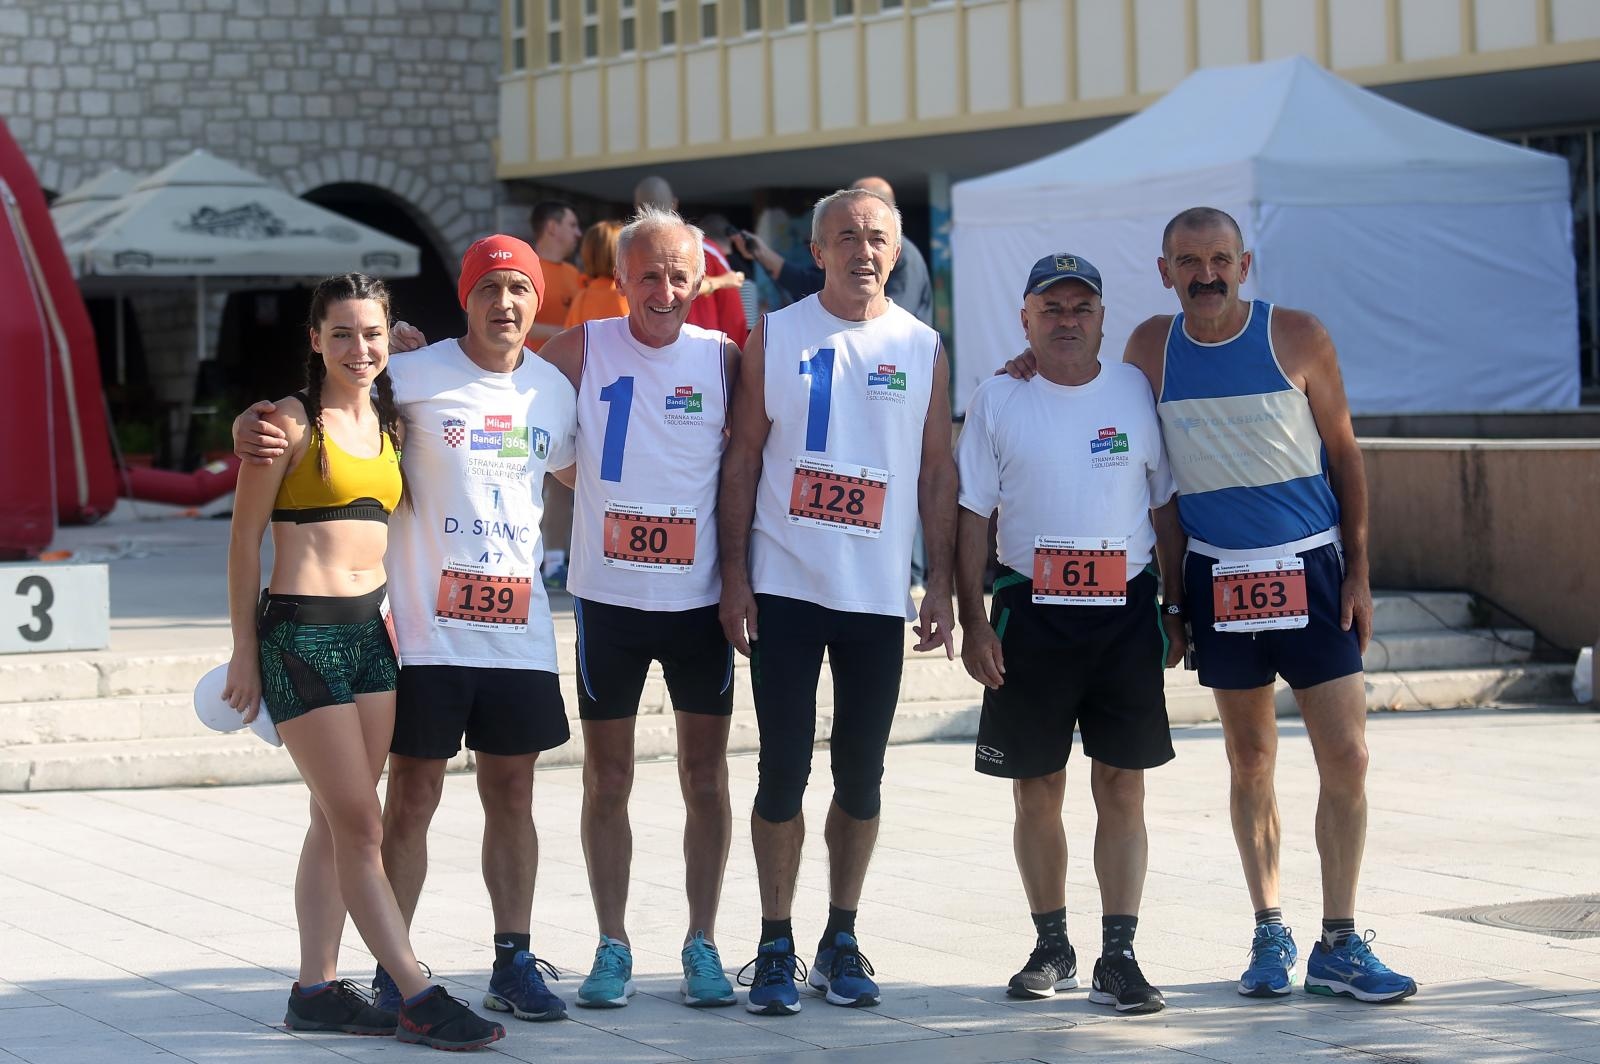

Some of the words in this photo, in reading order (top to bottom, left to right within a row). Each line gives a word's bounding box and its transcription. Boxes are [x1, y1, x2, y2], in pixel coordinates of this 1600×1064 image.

[488, 250, 513, 260] vip
[892, 377, 905, 386] 365
[688, 400, 701, 408] 365
[799, 348, 836, 452] 1
[486, 418, 511, 429] Milan
[1201, 411, 1284, 427] VOLKSBANK
[600, 376, 634, 482] 1
[471, 433, 502, 446] Bandić
[505, 436, 526, 450] 365
[468, 458, 504, 468] STRANKA
[506, 462, 527, 473] RADA
[492, 490, 499, 509] 1
[808, 482, 865, 515] 128
[444, 517, 464, 534] D.
[629, 526, 667, 553] 80
[1062, 560, 1098, 587] 61
[459, 584, 514, 613] 139
[1233, 581, 1287, 610] 163
[16, 575, 54, 643] 3
